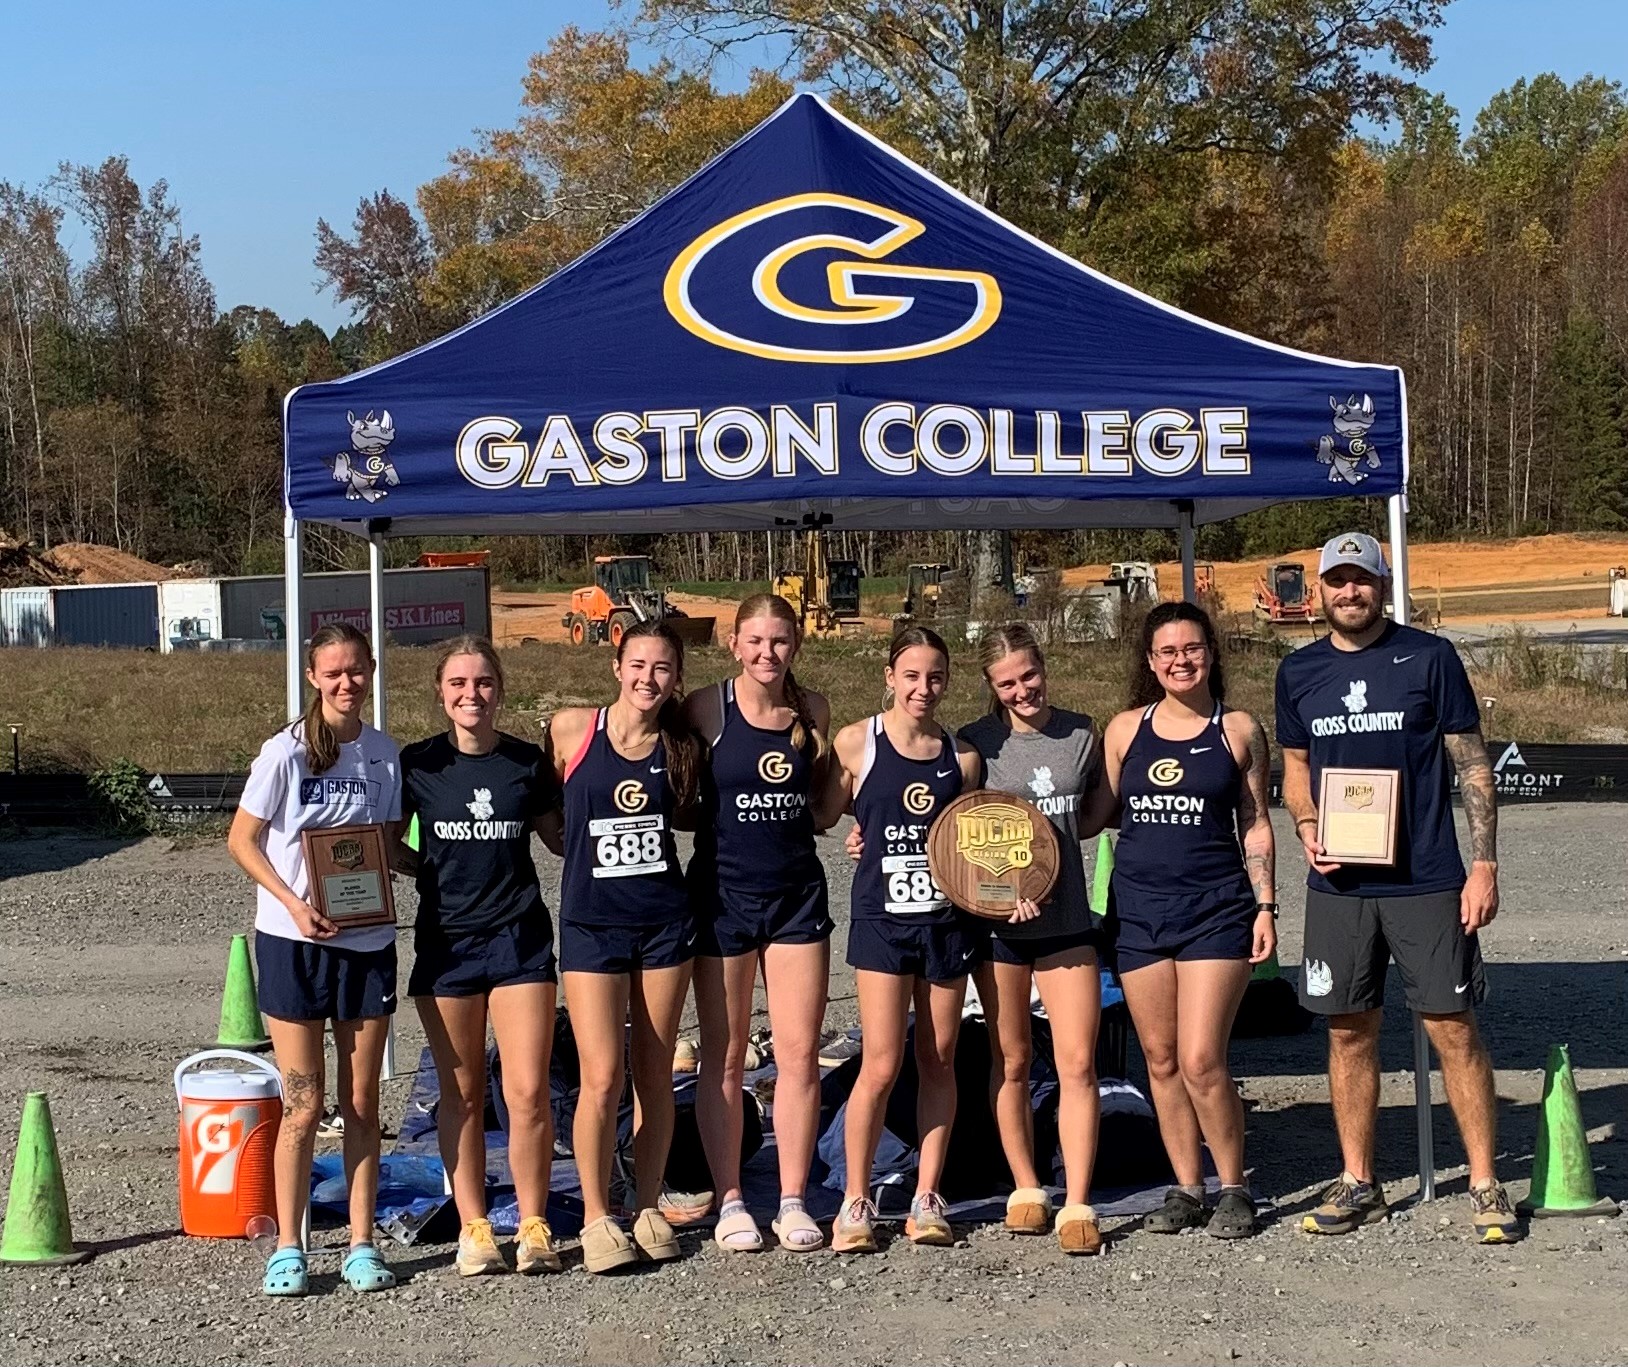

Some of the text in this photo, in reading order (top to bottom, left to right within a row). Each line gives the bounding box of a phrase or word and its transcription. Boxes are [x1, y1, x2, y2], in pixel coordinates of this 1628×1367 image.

[664, 192, 1003, 364] G
[456, 401, 1251, 489] GASTON COLLEGE
[1312, 711, 1405, 737] CROSS COUNTRY
[758, 751, 793, 784] G
[1148, 758, 1184, 787] G
[328, 780, 367, 796] GASTON
[614, 779, 649, 814] G
[903, 782, 935, 815] G
[735, 793, 806, 809] GASTON
[1037, 794, 1079, 816] COUNT
[1129, 795, 1205, 813] GASTON
[737, 808, 802, 822] COLLEGE
[1132, 812, 1202, 826] COLLEGE
[434, 821, 524, 840] CROSS COUNTRY
[884, 824, 928, 840] GAST
[597, 831, 662, 867] 688
[887, 842, 928, 854] COLL
[1015, 850, 1027, 861] 10
[197, 1113, 230, 1154] G
